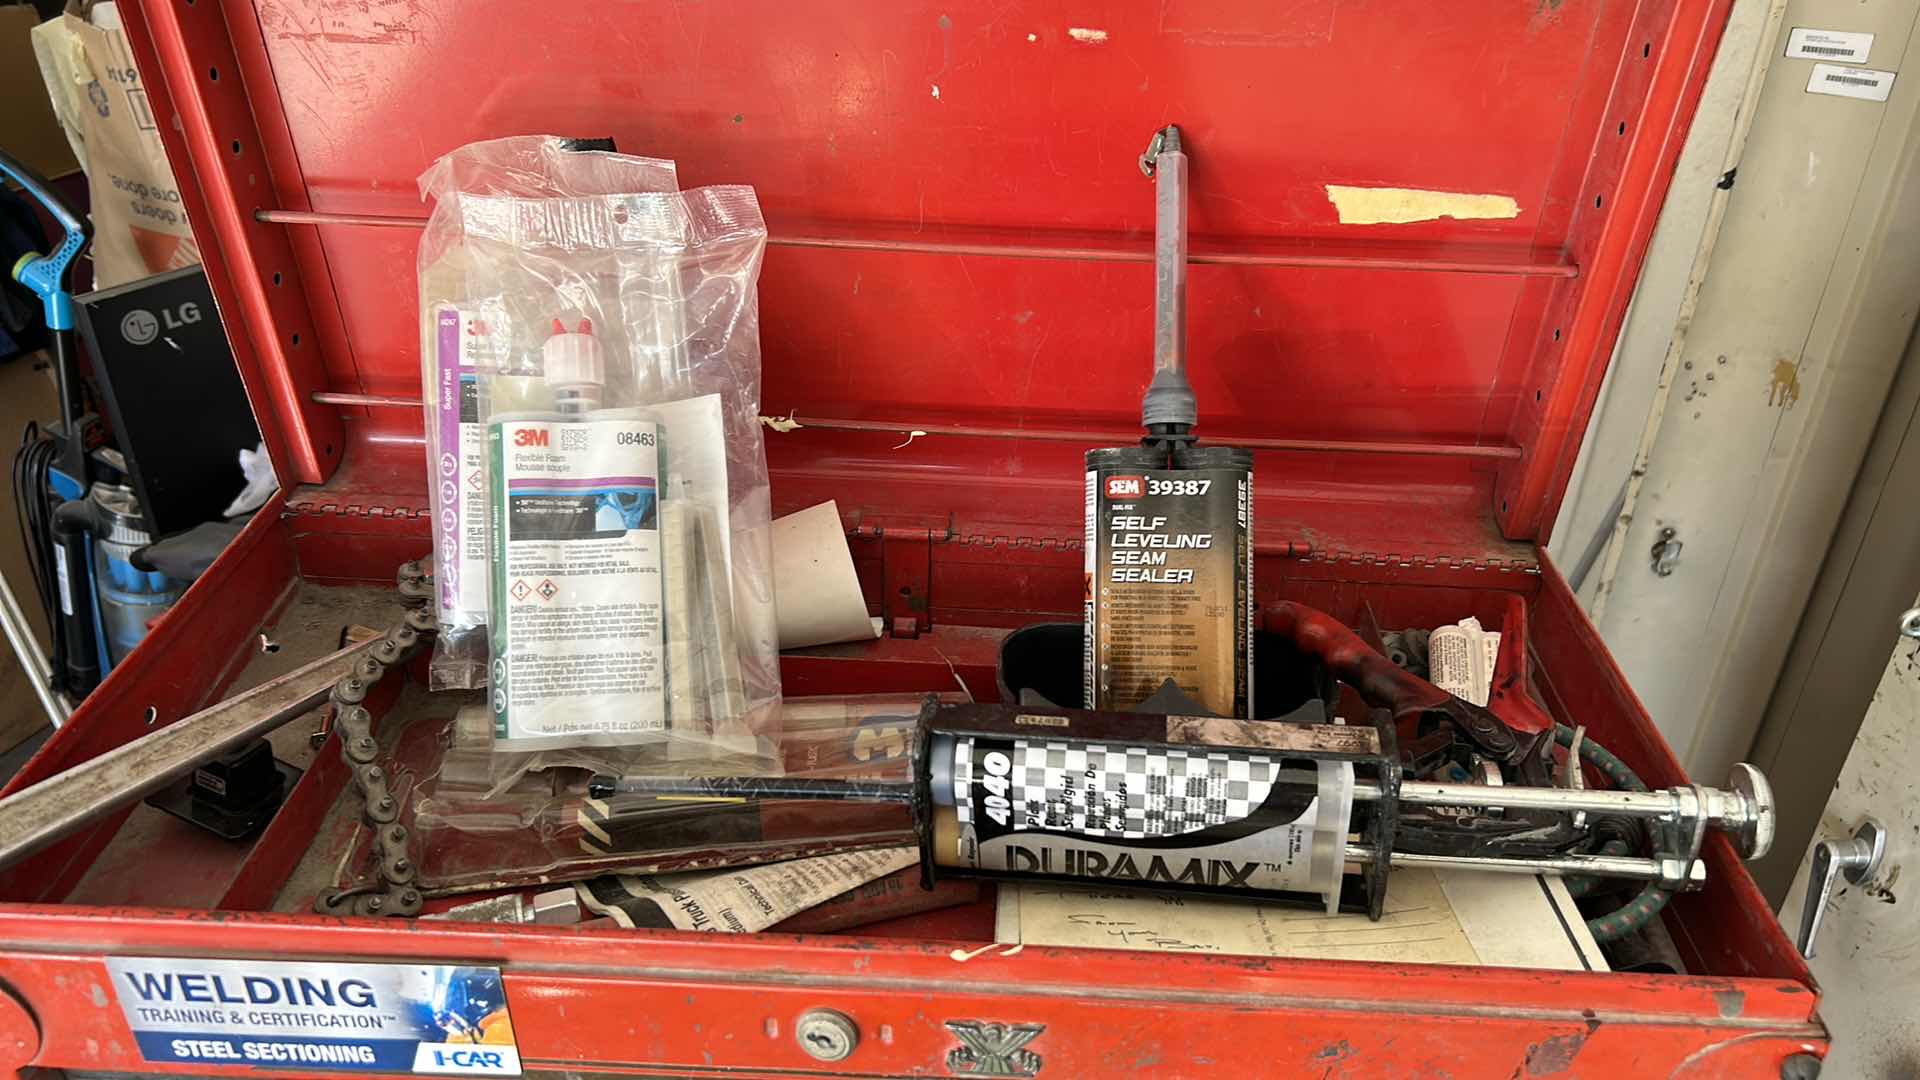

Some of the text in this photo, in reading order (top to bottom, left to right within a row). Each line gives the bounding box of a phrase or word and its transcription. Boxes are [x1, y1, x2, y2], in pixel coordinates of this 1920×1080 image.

[162, 301, 202, 331] LG
[443, 368, 453, 411] Super Fast
[514, 429, 549, 447] 3M
[617, 432, 655, 446] 08463
[515, 454, 566, 462] Flexible Foam
[1109, 480, 1140, 494] SEM
[1148, 480, 1212, 495] 39387
[1238, 480, 1247, 529] 39387
[1111, 516, 1168, 530] SELF
[1111, 534, 1212, 548] LEVELING
[1111, 551, 1167, 565] SEAM
[1111, 569, 1194, 583] SEALER
[984, 751, 1012, 826] 4040
[681, 897, 709, 930] Truck
[126, 971, 378, 1008] WELDING
[138, 1008, 227, 1024] TRAINING
[231, 1011, 244, 1024] &
[172, 1039, 376, 1063] STEEL SECTIONING
[434, 1050, 504, 1068] I-CAR
